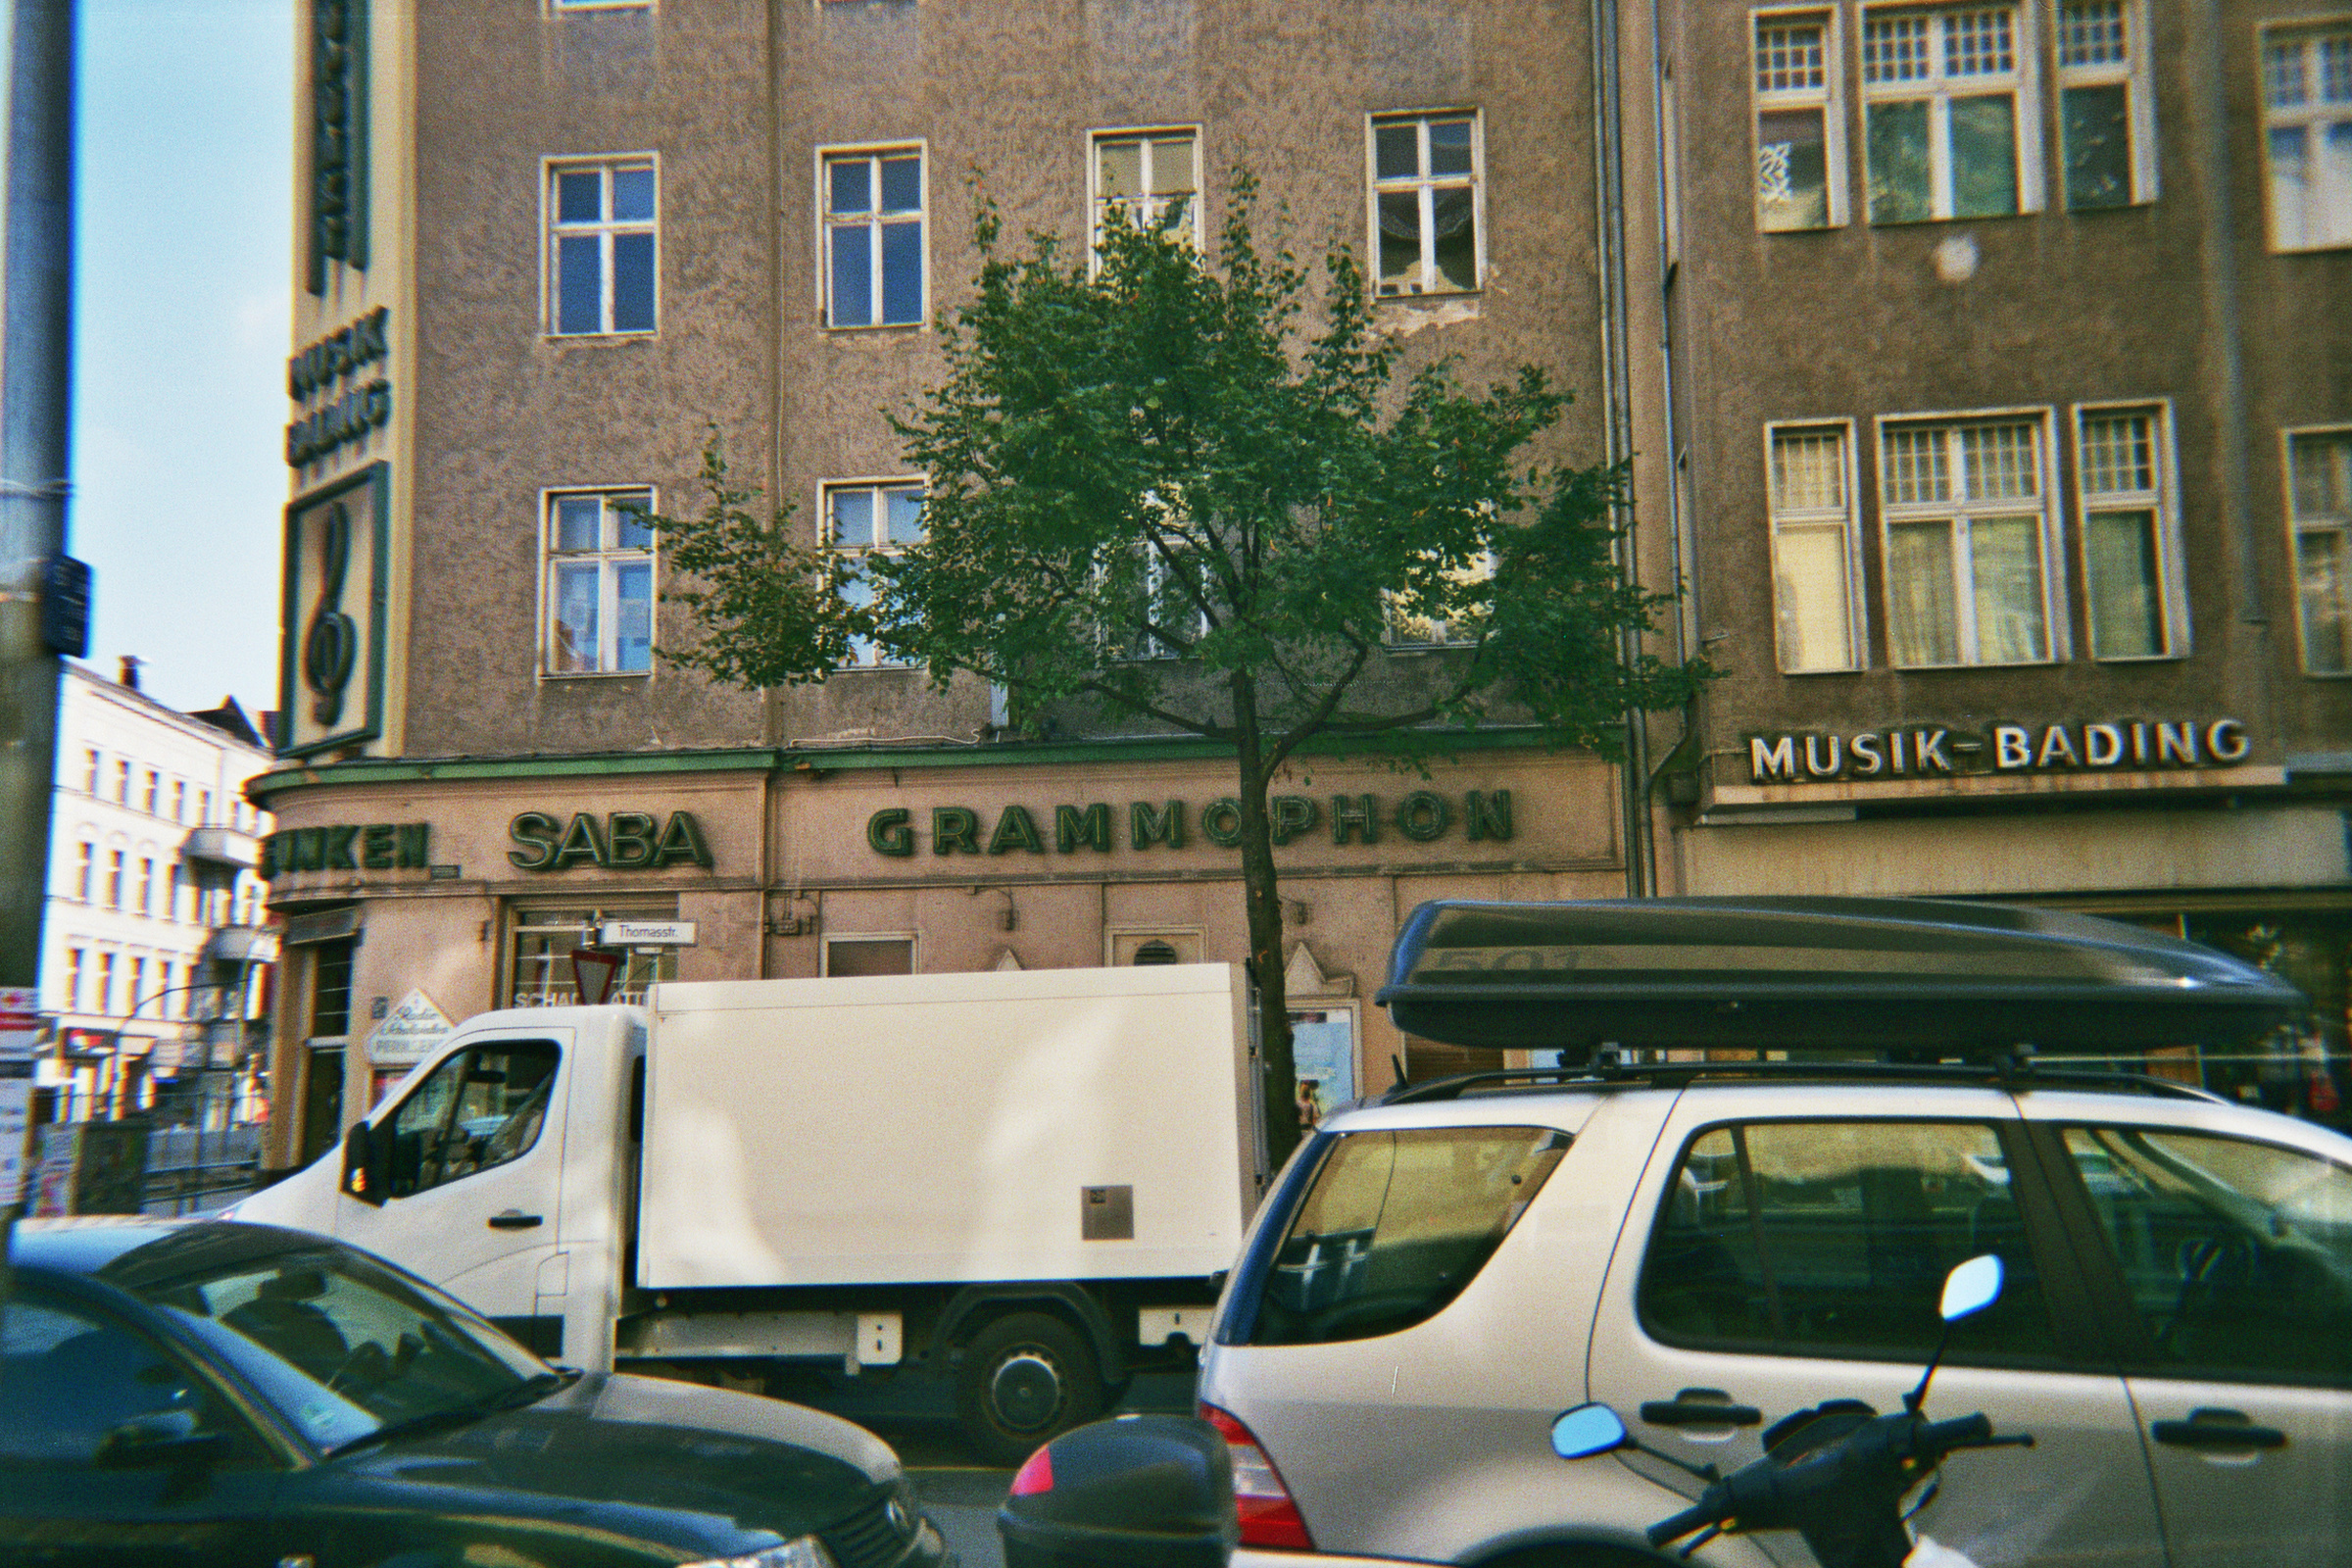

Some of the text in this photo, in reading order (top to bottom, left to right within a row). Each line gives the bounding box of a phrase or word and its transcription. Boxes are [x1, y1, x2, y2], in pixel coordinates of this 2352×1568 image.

[507, 810, 713, 871] SABA
[866, 788, 1513, 857] GRAMMOPHON
[618, 923, 679, 939] Thomasstr.
